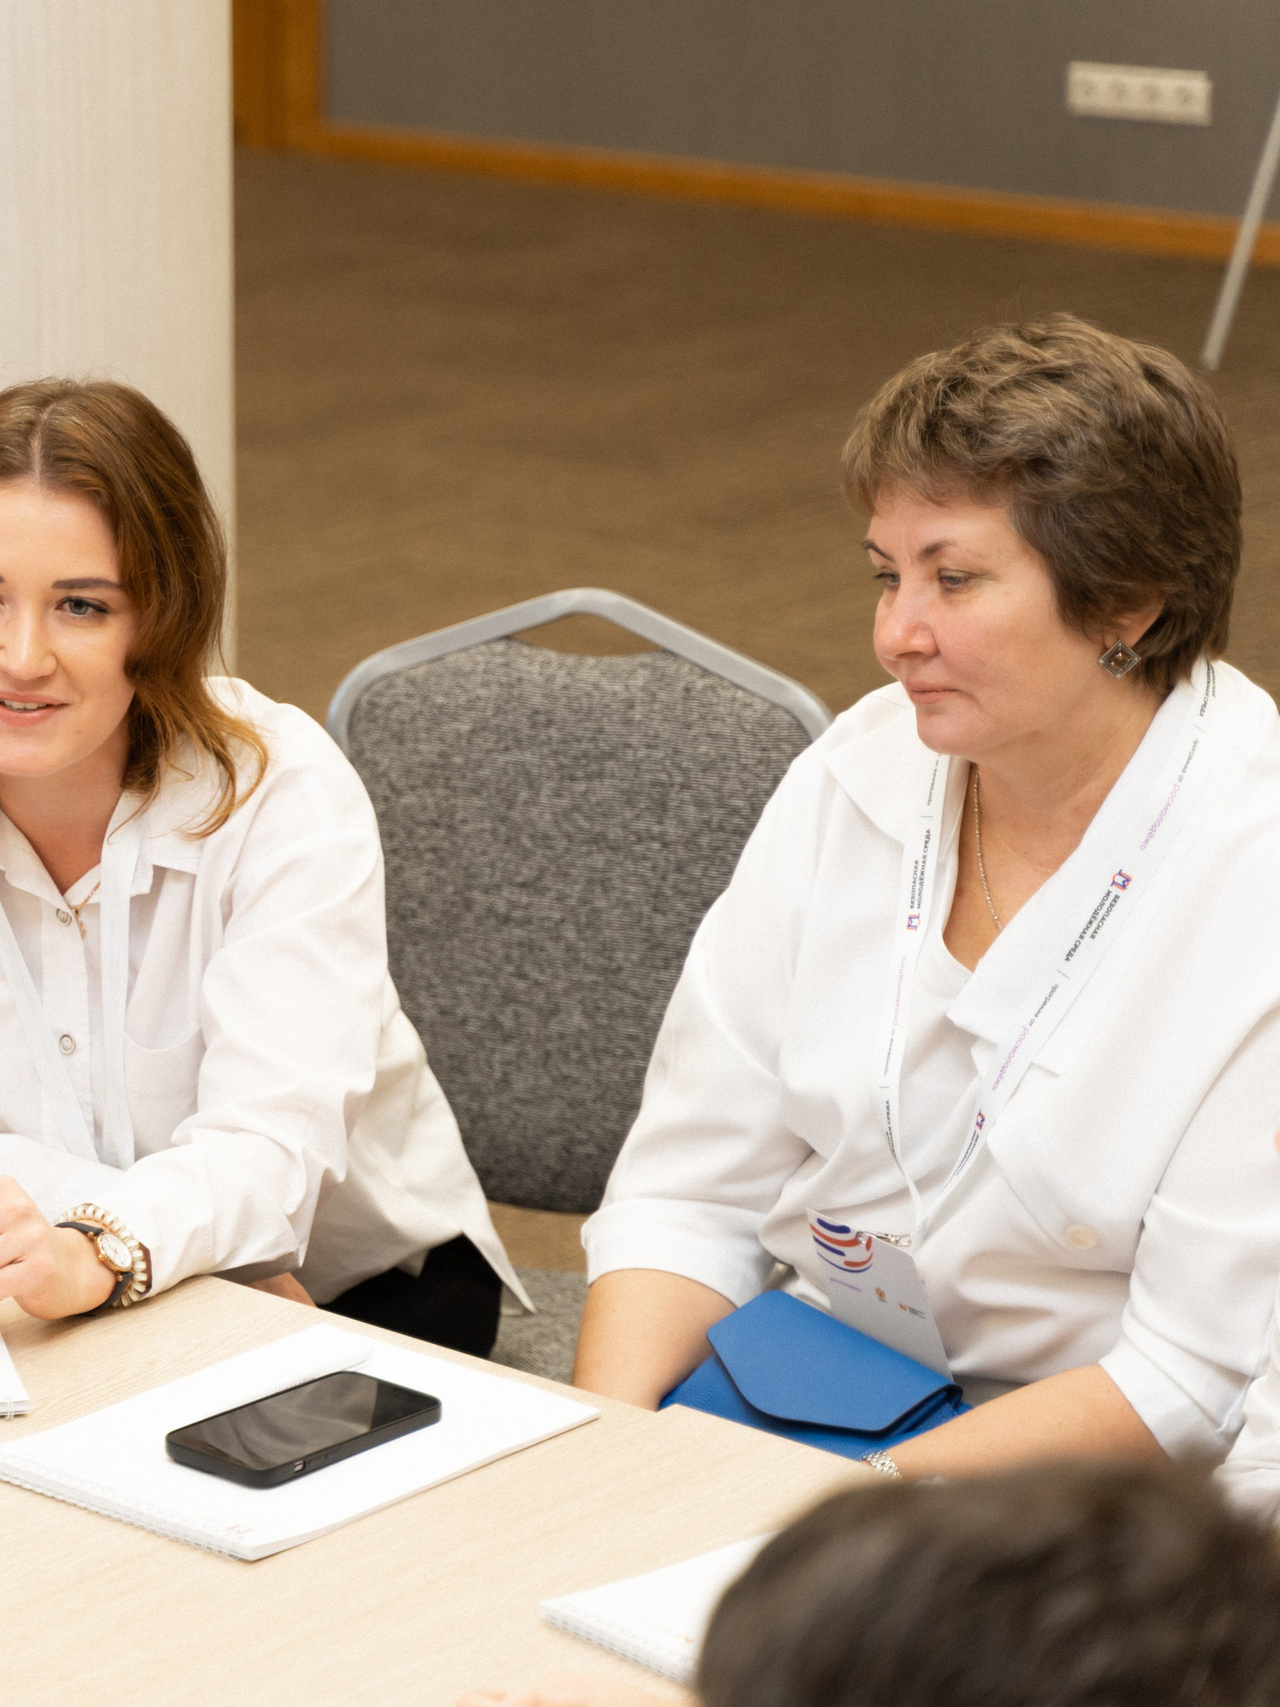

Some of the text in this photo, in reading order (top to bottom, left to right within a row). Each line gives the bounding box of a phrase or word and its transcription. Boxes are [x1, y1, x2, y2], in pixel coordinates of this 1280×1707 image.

[923, 829, 931, 854] СРЕДА
[910, 860, 919, 909] БЕЗОПАСНАЯ
[1090, 894, 1120, 940] БЕЗОПАСНАЯ
[1064, 939, 1081, 961] СРЕДА
